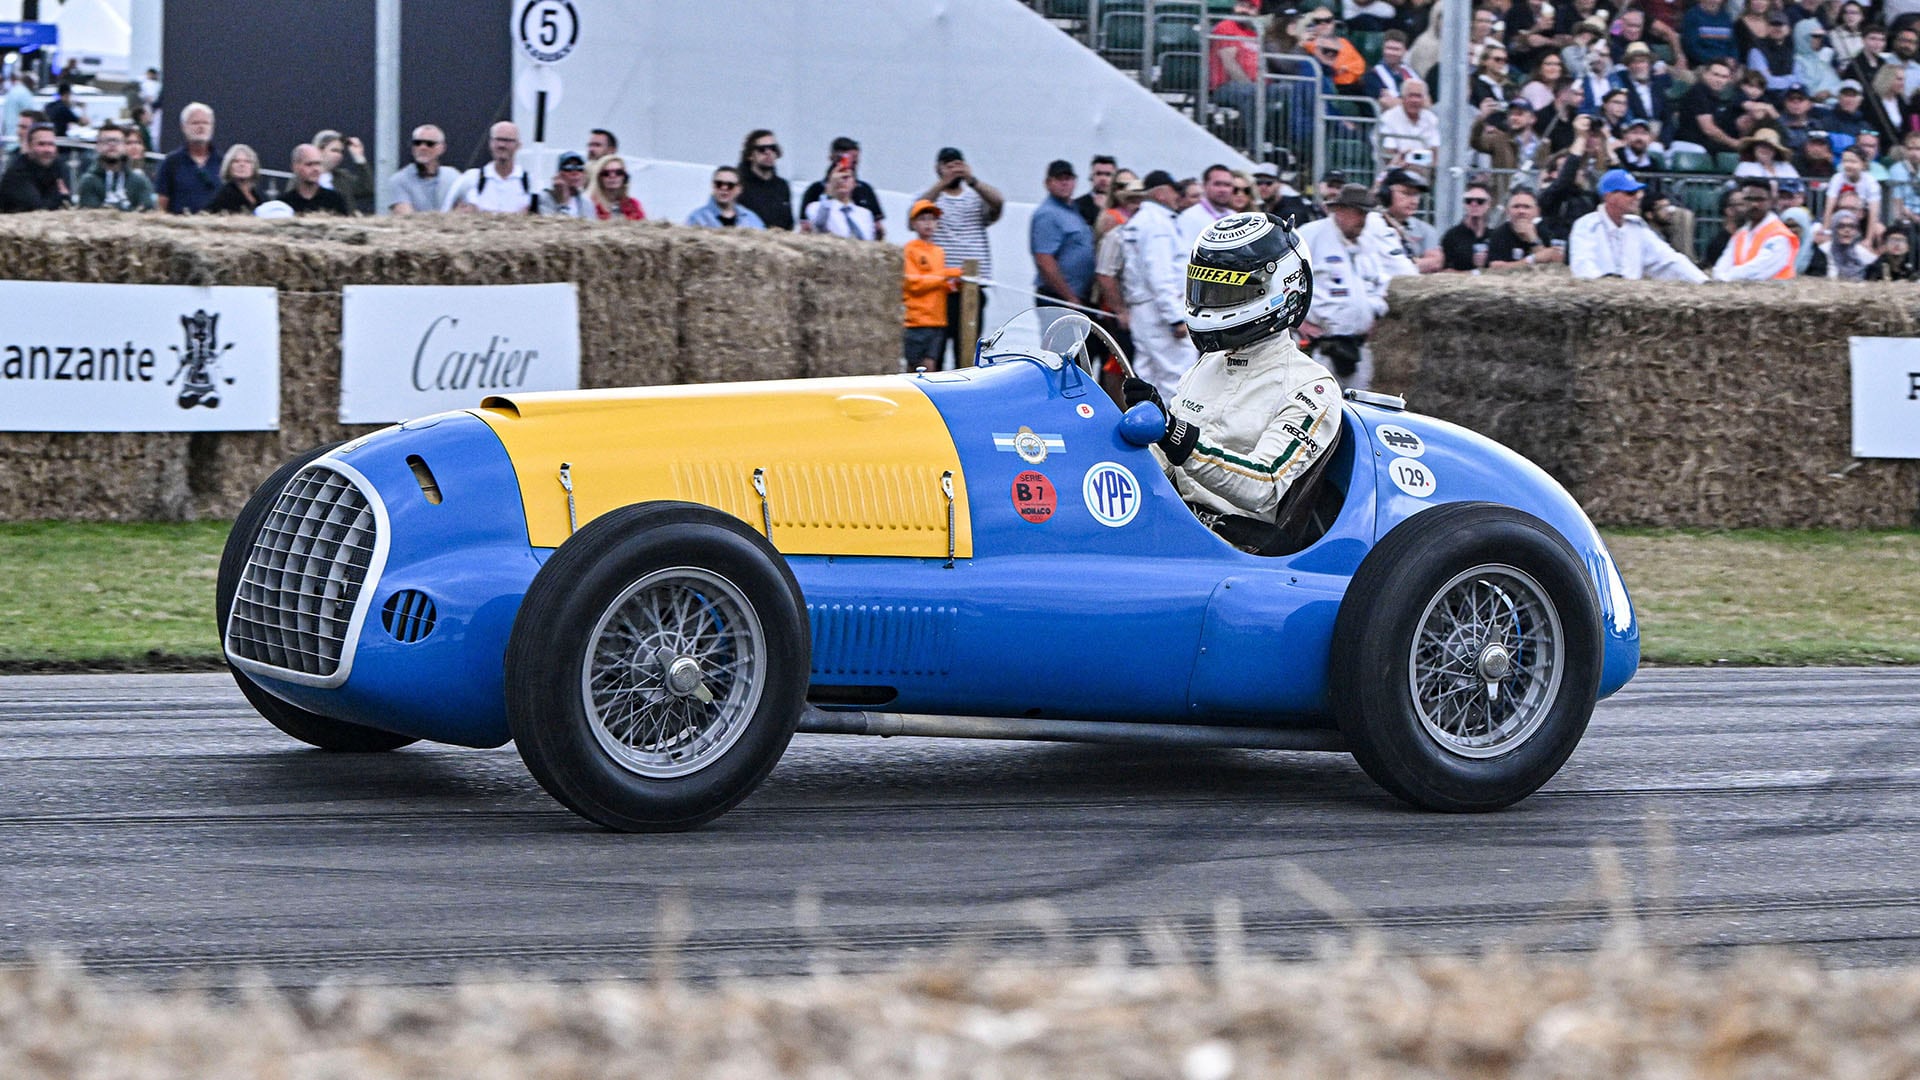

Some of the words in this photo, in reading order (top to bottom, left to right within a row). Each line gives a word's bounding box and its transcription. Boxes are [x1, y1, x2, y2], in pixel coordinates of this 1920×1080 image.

[540, 9, 557, 46] 5
[0, 341, 155, 382] anzante
[412, 315, 539, 392] Cartier
[1081, 406, 1090, 414] B
[1282, 423, 1318, 452] RECARO
[1016, 483, 1032, 501] B
[1036, 486, 1043, 501] 7
[1020, 474, 1043, 482] SERIE
[1092, 471, 1132, 517] YPF
[1021, 507, 1051, 515] MONACO
